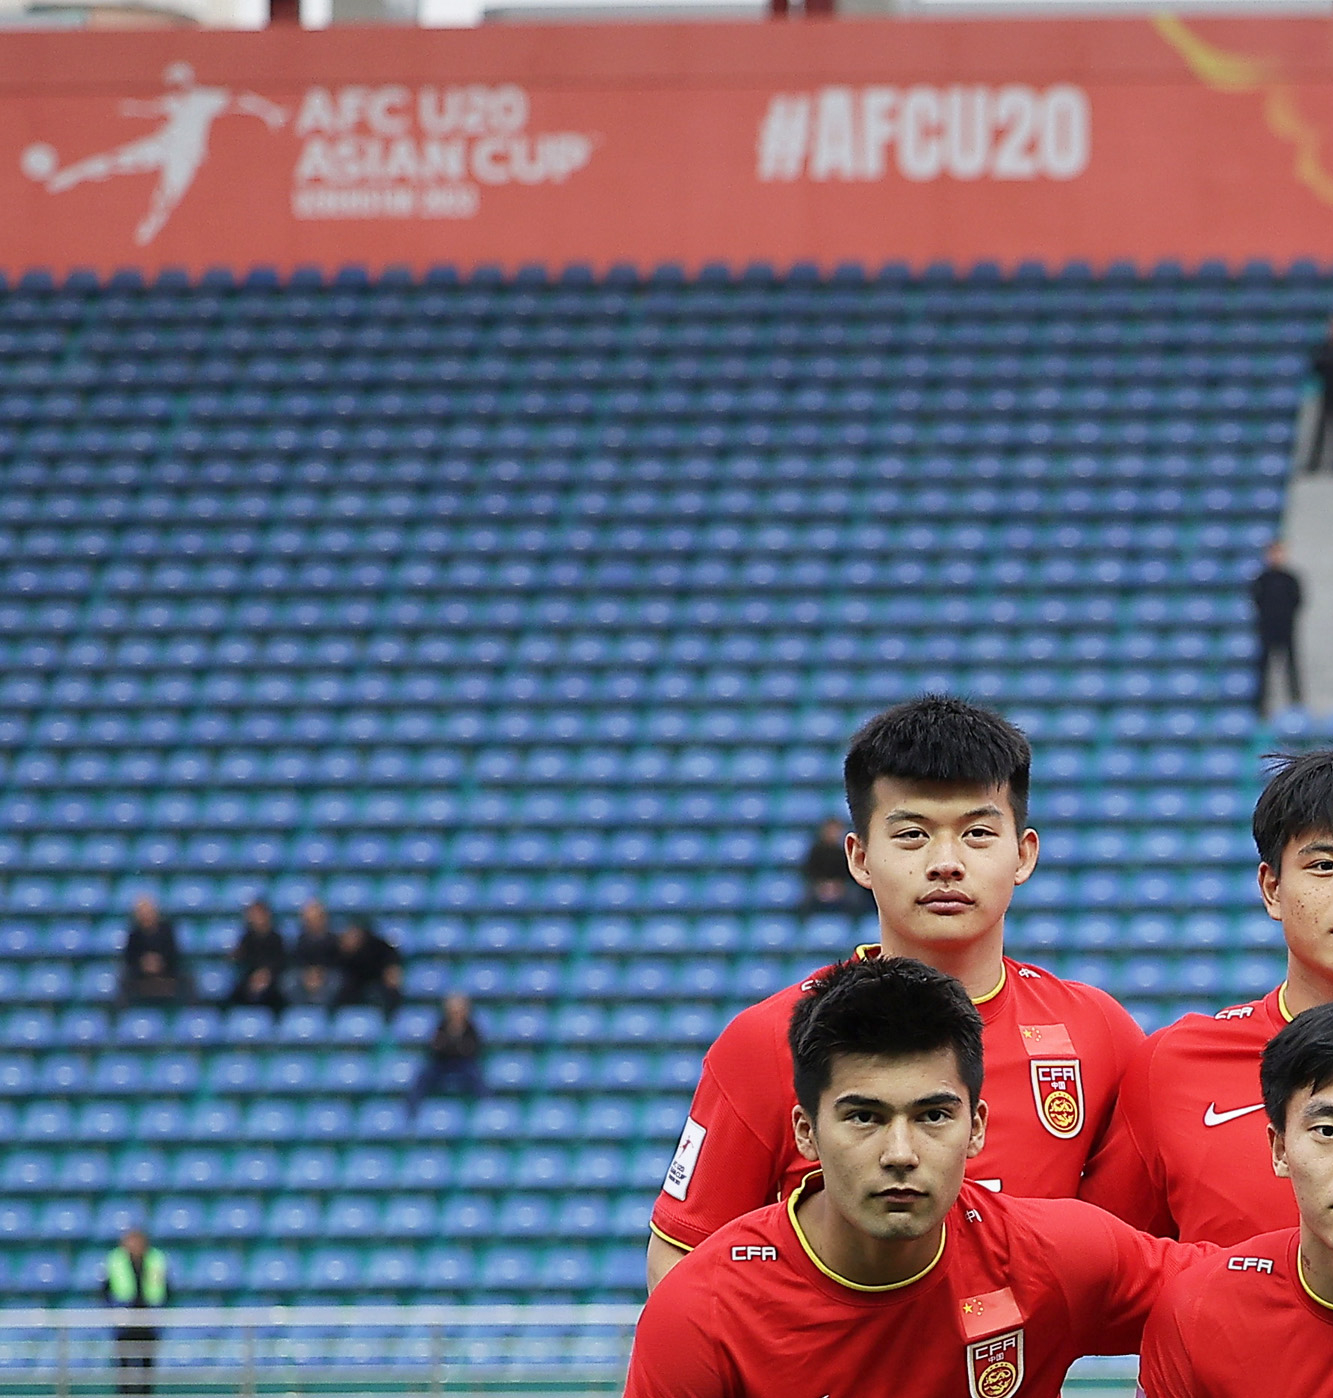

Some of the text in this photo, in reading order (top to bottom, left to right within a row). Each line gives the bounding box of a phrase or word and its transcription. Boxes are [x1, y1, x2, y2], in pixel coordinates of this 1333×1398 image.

[296, 84, 529, 136] AFC U20
[756, 84, 1090, 181] #AFCU20
[294, 133, 596, 184] ASIAN CUP
[1214, 1006, 1254, 1020] CFA
[1038, 1067, 1075, 1082] CFA
[731, 1246, 777, 1261] CFA
[1228, 1257, 1274, 1274] CFA
[975, 1337, 1016, 1360] CFA
